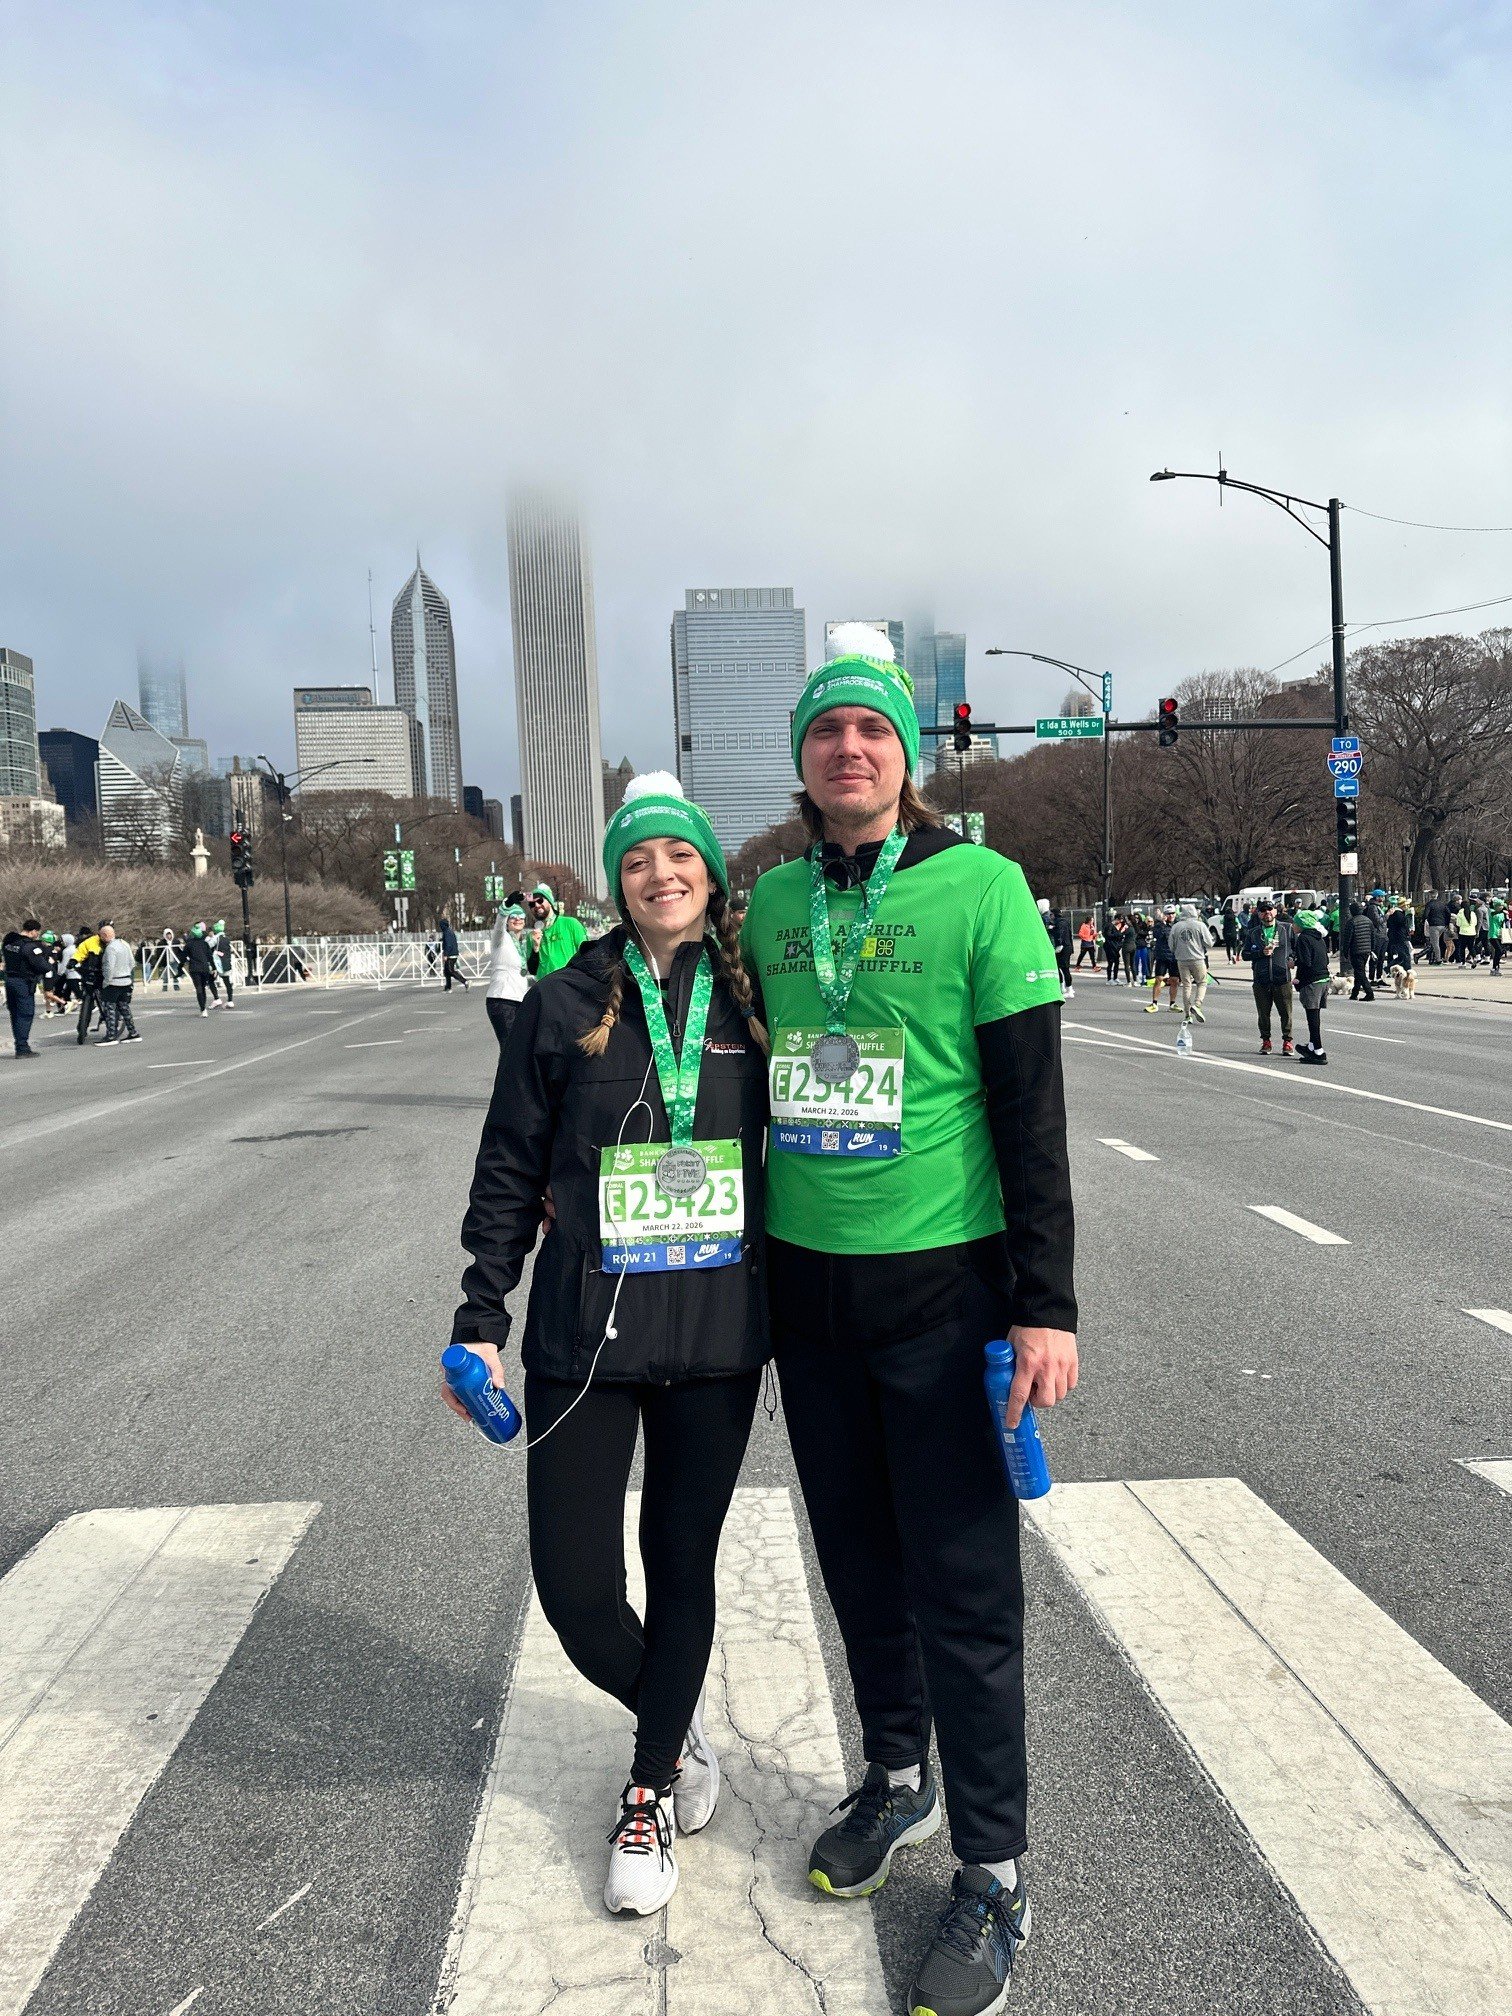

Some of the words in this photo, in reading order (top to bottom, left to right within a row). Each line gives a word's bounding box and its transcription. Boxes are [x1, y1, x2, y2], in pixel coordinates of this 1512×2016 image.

[1047, 720, 1058, 730] Ida
[1069, 720, 1090, 728] Wells
[1340, 740, 1352, 749] TO
[1334, 760, 1357, 775] 290
[775, 926, 810, 942] BANK
[856, 960, 923, 974] HUFFLE
[775, 1069, 788, 1100] E
[793, 1062, 898, 1106] 25424
[801, 1107, 827, 1115] MARCH
[828, 1108, 839, 1116] 22,
[841, 1108, 859, 1116] 2026
[780, 1132, 798, 1144] ROW
[800, 1134, 811, 1144] 21
[852, 1132, 874, 1143] RUN
[608, 1189, 623, 1220] E
[630, 1176, 738, 1220] 25423
[642, 1223, 670, 1232] MARCH
[671, 1223, 683, 1231] 22,
[685, 1222, 704, 1230] 2026
[699, 1243, 719, 1254] RUN
[612, 1253, 641, 1264] ROW
[643, 1252, 656, 1263] 21
[482, 1377, 510, 1422] Culligan
